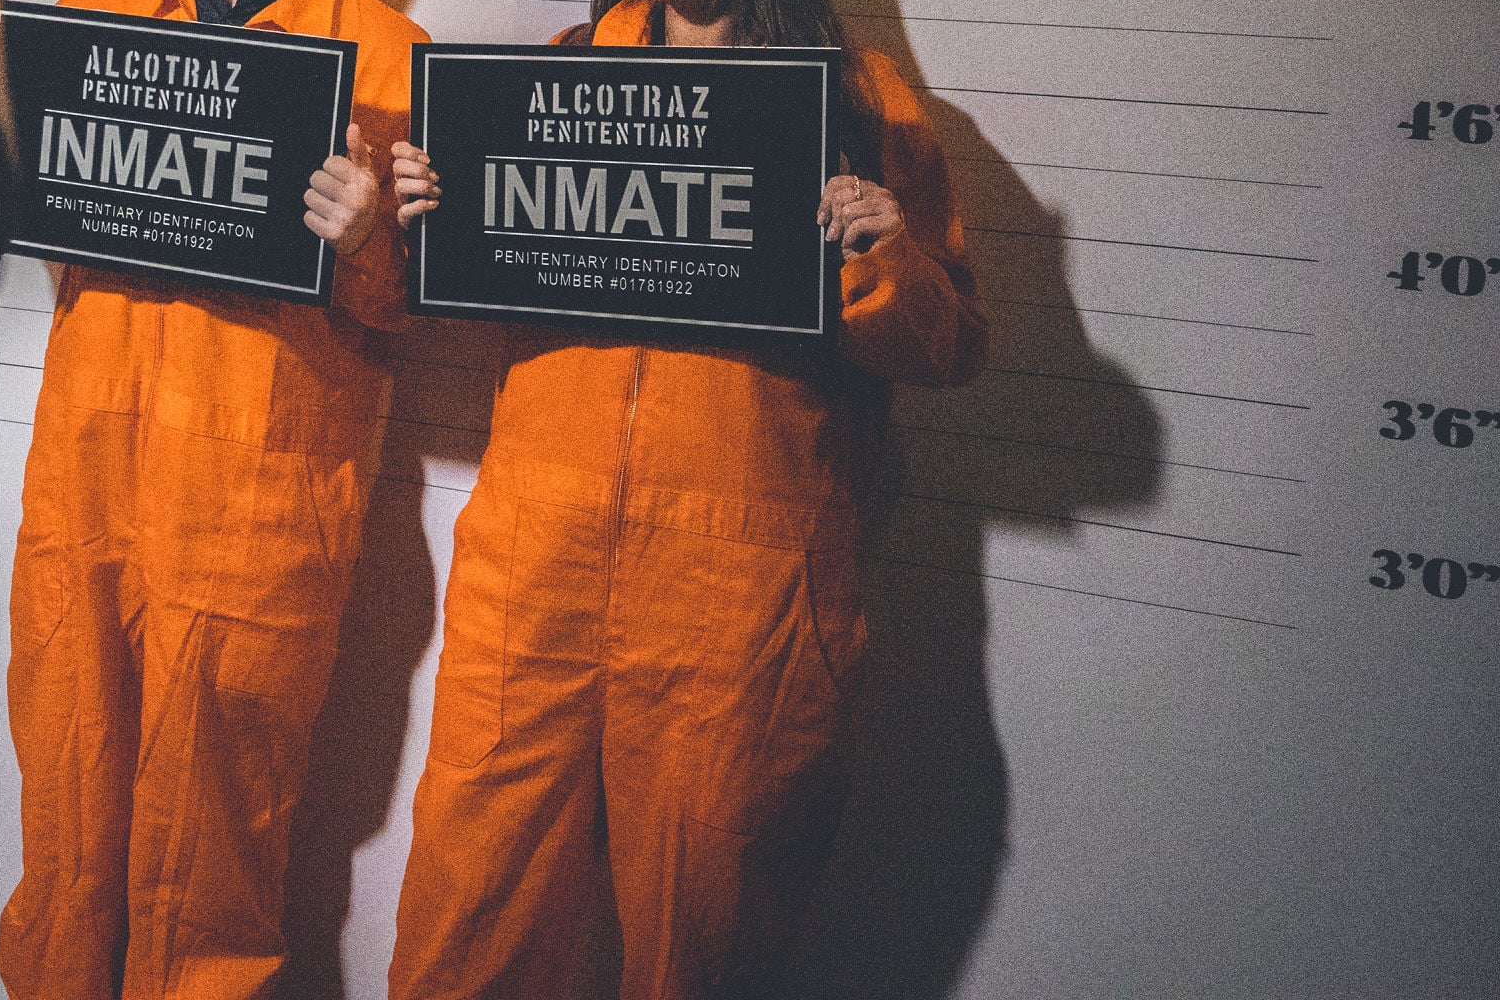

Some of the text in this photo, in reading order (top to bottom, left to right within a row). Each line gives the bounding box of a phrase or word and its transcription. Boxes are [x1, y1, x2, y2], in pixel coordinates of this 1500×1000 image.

[84, 45, 242, 94] ALCOTRAZ
[82, 78, 237, 120] PENITENTIARY
[528, 81, 710, 119] ALCOTRAZ
[528, 118, 707, 148] PENITENTIARY
[1397, 101, 1500, 144] 4’6
[38, 116, 273, 207] INMATE
[46, 194, 255, 239] PENITENTIARY IDENTIFICATON
[483, 162, 754, 242] INMATE
[82, 218, 213, 251] NUMBER #01781922
[495, 250, 740, 278] PENITENTIARY IDENTIFICATON
[537, 271, 693, 296] NUMBER #01781922
